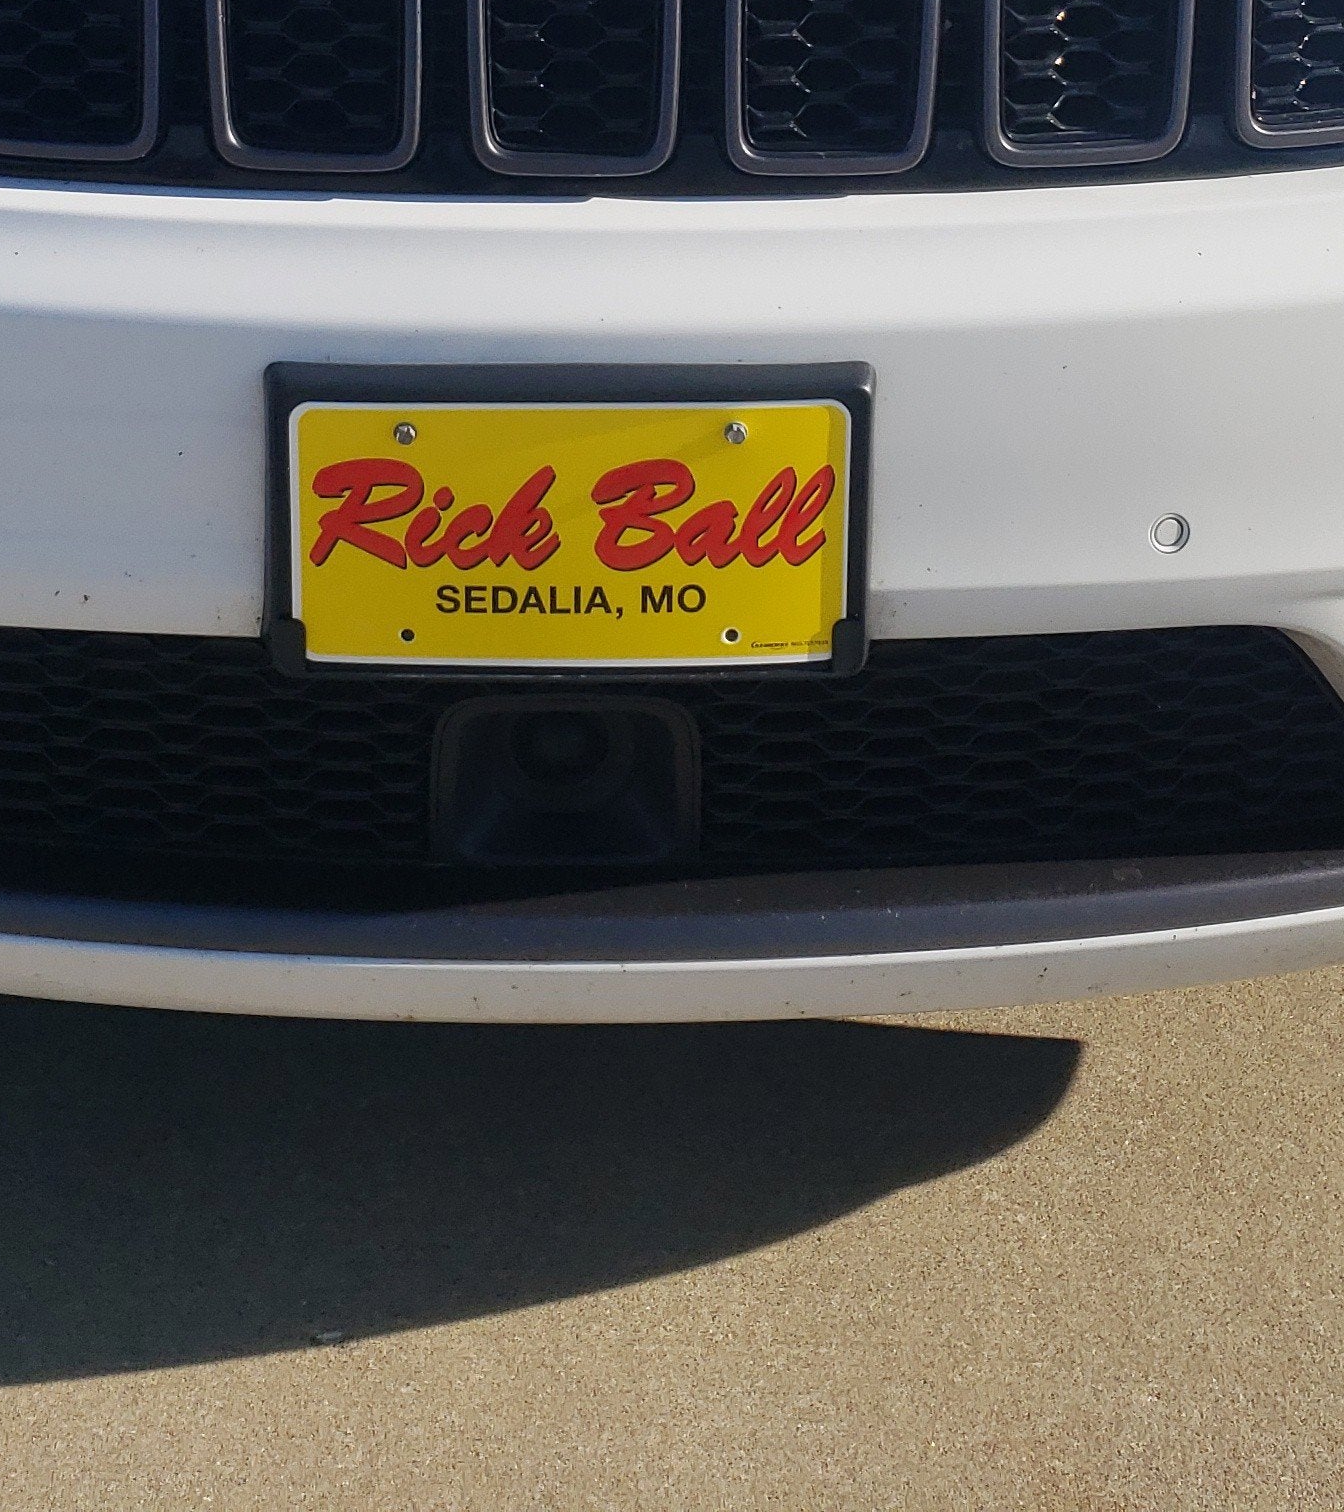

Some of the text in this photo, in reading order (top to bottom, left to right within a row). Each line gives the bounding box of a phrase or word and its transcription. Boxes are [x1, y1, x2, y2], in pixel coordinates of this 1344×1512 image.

[309, 458, 836, 570] Rick Ball
[435, 584, 707, 620] SEDALIA, MO
